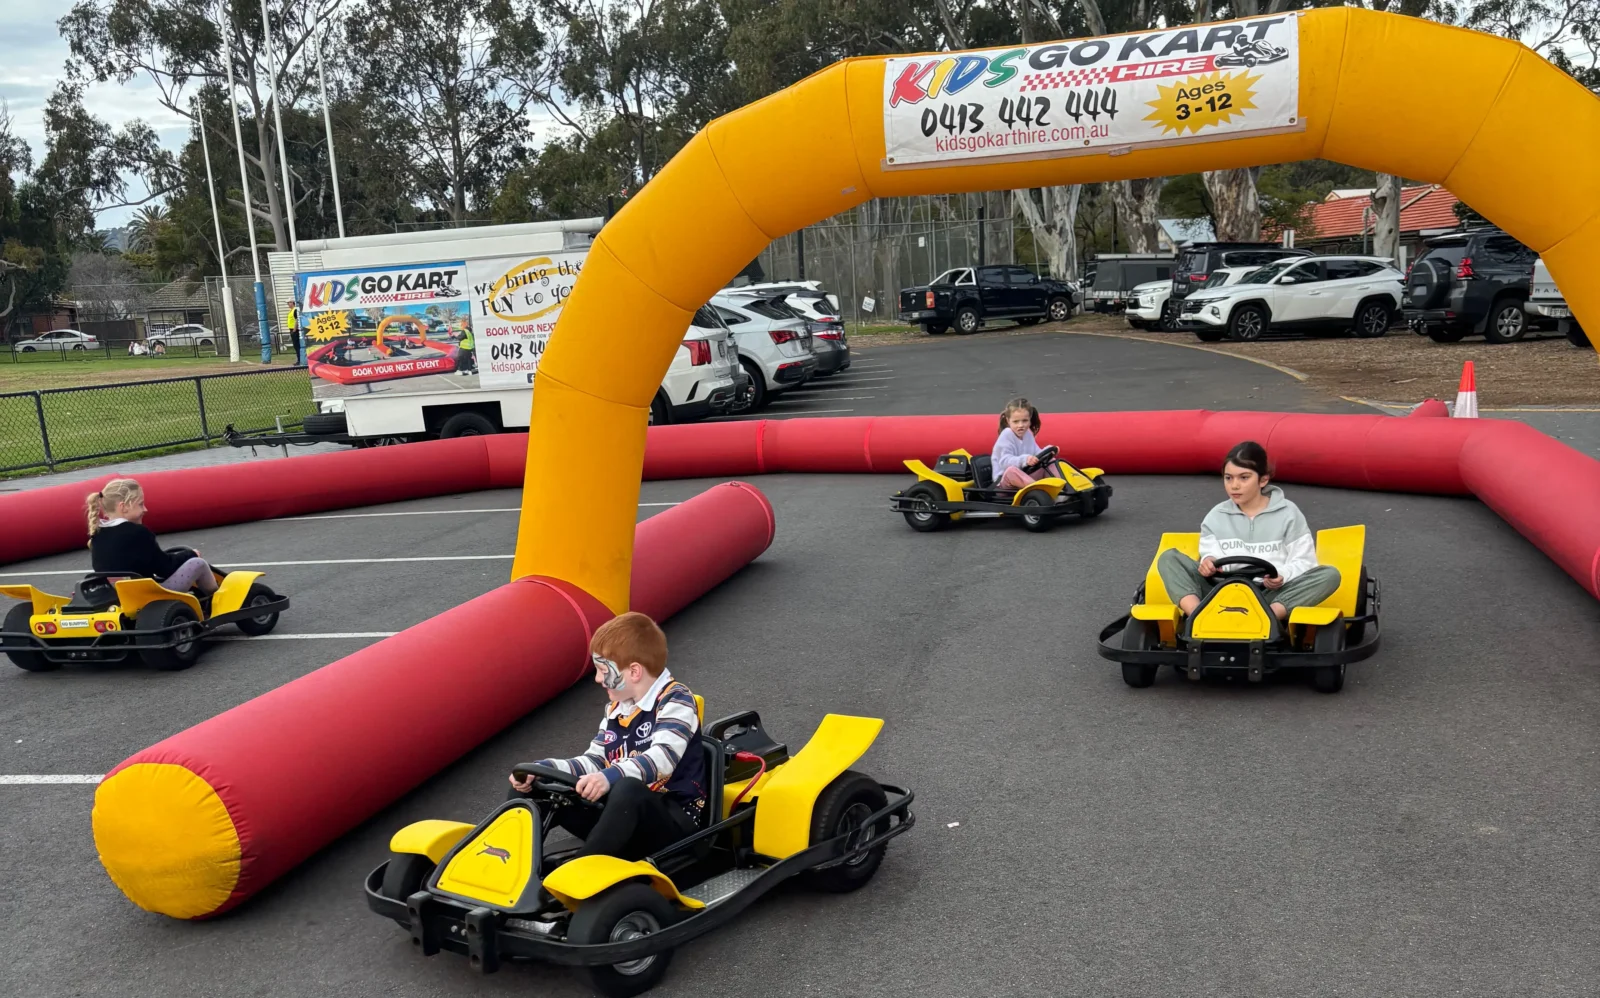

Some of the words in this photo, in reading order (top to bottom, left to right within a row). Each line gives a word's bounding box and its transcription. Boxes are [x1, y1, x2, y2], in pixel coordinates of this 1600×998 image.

[889, 49, 1028, 109] KIDS
[1028, 39, 1113, 71] GO
[1117, 18, 1285, 62] KART
[1117, 58, 1208, 80] HIRE
[1174, 80, 1226, 103] Ages
[920, 102, 985, 138] 0413
[998, 96, 1051, 130] 442
[1065, 87, 1119, 122] 444
[935, 121, 1109, 153] kidsgokarthire.com.au
[504, 268, 550, 288] bring
[308, 275, 361, 309] KIDS
[361, 275, 393, 294] GO
[396, 270, 459, 292] KART
[396, 292, 432, 300] HIRE
[480, 293, 516, 316] FUN
[524, 292, 544, 306] to
[551, 284, 574, 305] yo
[316, 314, 337, 326] Ages
[485, 327, 510, 337] BOOK
[511, 324, 534, 335] YOUR
[491, 342, 523, 360] 0413
[529, 340, 548, 357] 44
[352, 366, 373, 377] BOOK
[374, 364, 394, 375] YOUR
[395, 362, 414, 372] NEXT
[416, 360, 440, 370] EVENT
[491, 360, 540, 373] kidsgokart
